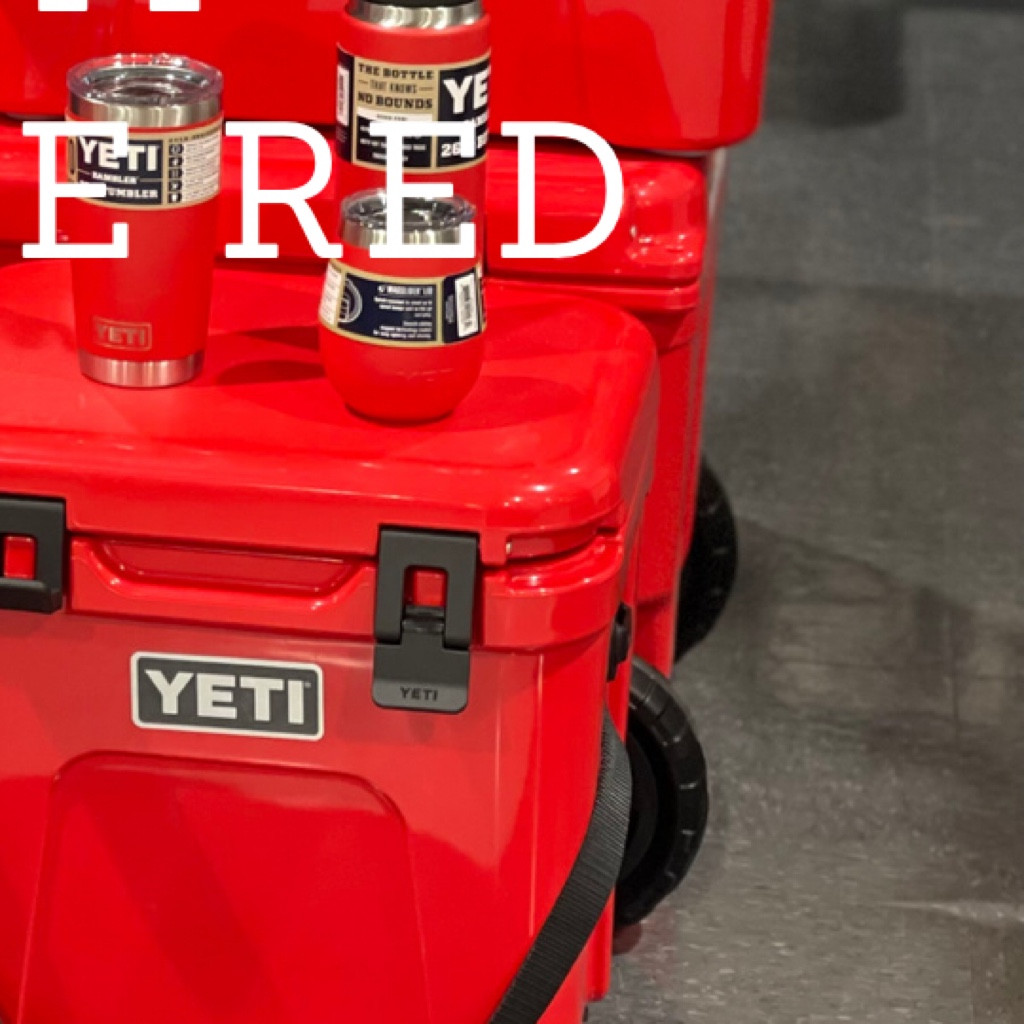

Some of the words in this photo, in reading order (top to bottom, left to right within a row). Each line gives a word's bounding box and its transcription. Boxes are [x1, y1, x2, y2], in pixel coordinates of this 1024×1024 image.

[358, 63, 380, 76] THE
[382, 67, 433, 80] BOTTLE
[443, 64, 489, 114] YE
[357, 91, 373, 105] NO
[376, 94, 433, 109] BOUNDS
[79, 135, 158, 171] YETI
[92, 171, 137, 184] RAMBLER
[106, 187, 158, 198] UMBLER
[97, 324, 145, 345] YETI
[144, 668, 304, 725] YETI
[400, 686, 438, 701] YETI
